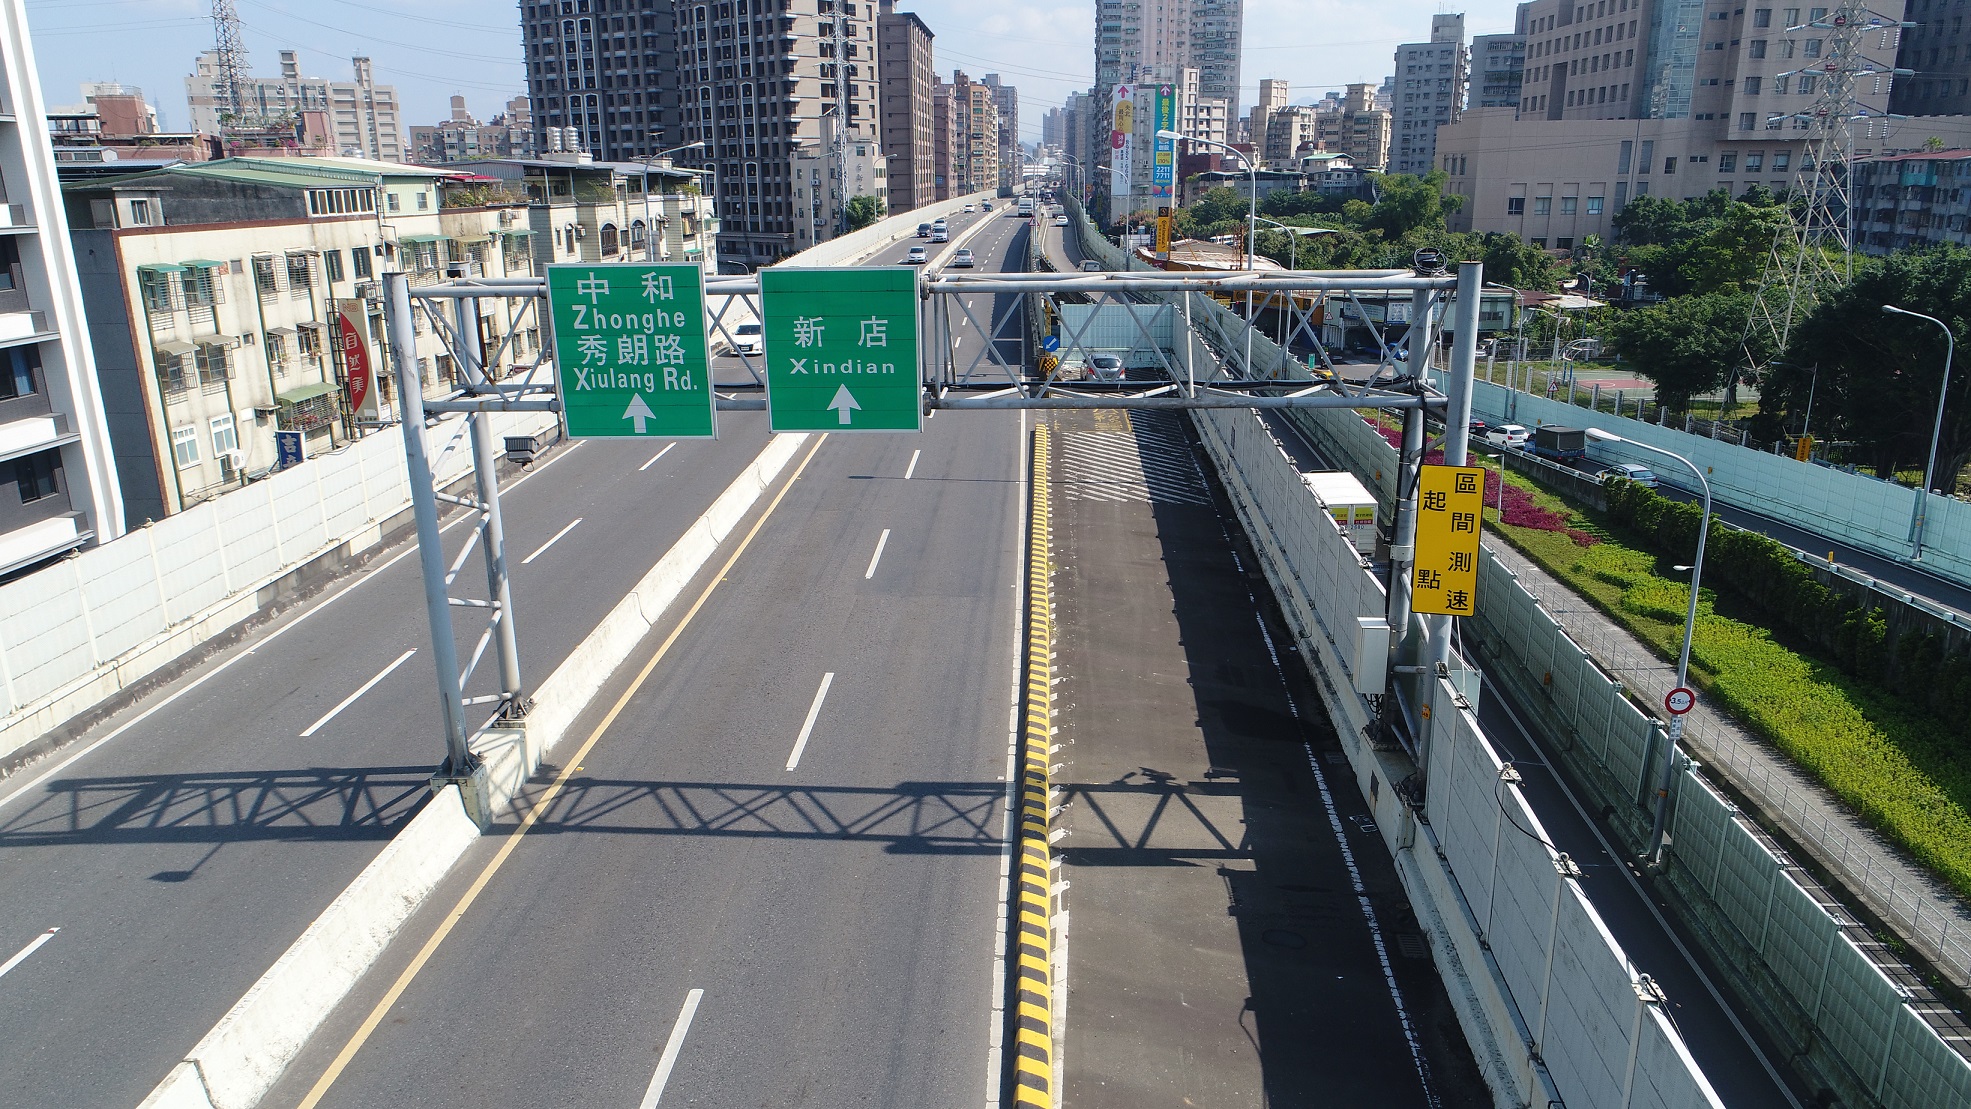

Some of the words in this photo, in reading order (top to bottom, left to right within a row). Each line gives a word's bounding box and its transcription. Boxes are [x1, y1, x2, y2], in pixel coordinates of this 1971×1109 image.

[576, 271, 674, 305] 中和
[572, 305, 686, 334] Zhonghe
[793, 315, 889, 349] 新店
[345, 332, 364, 394] 自然美
[576, 333, 687, 366] 秀朗路
[789, 357, 896, 375] Xindian
[574, 366, 655, 394] Xiulang
[663, 366, 698, 392] Rd.
[1416, 489, 1446, 590] 起點
[1445, 472, 1478, 611] 區間測速
